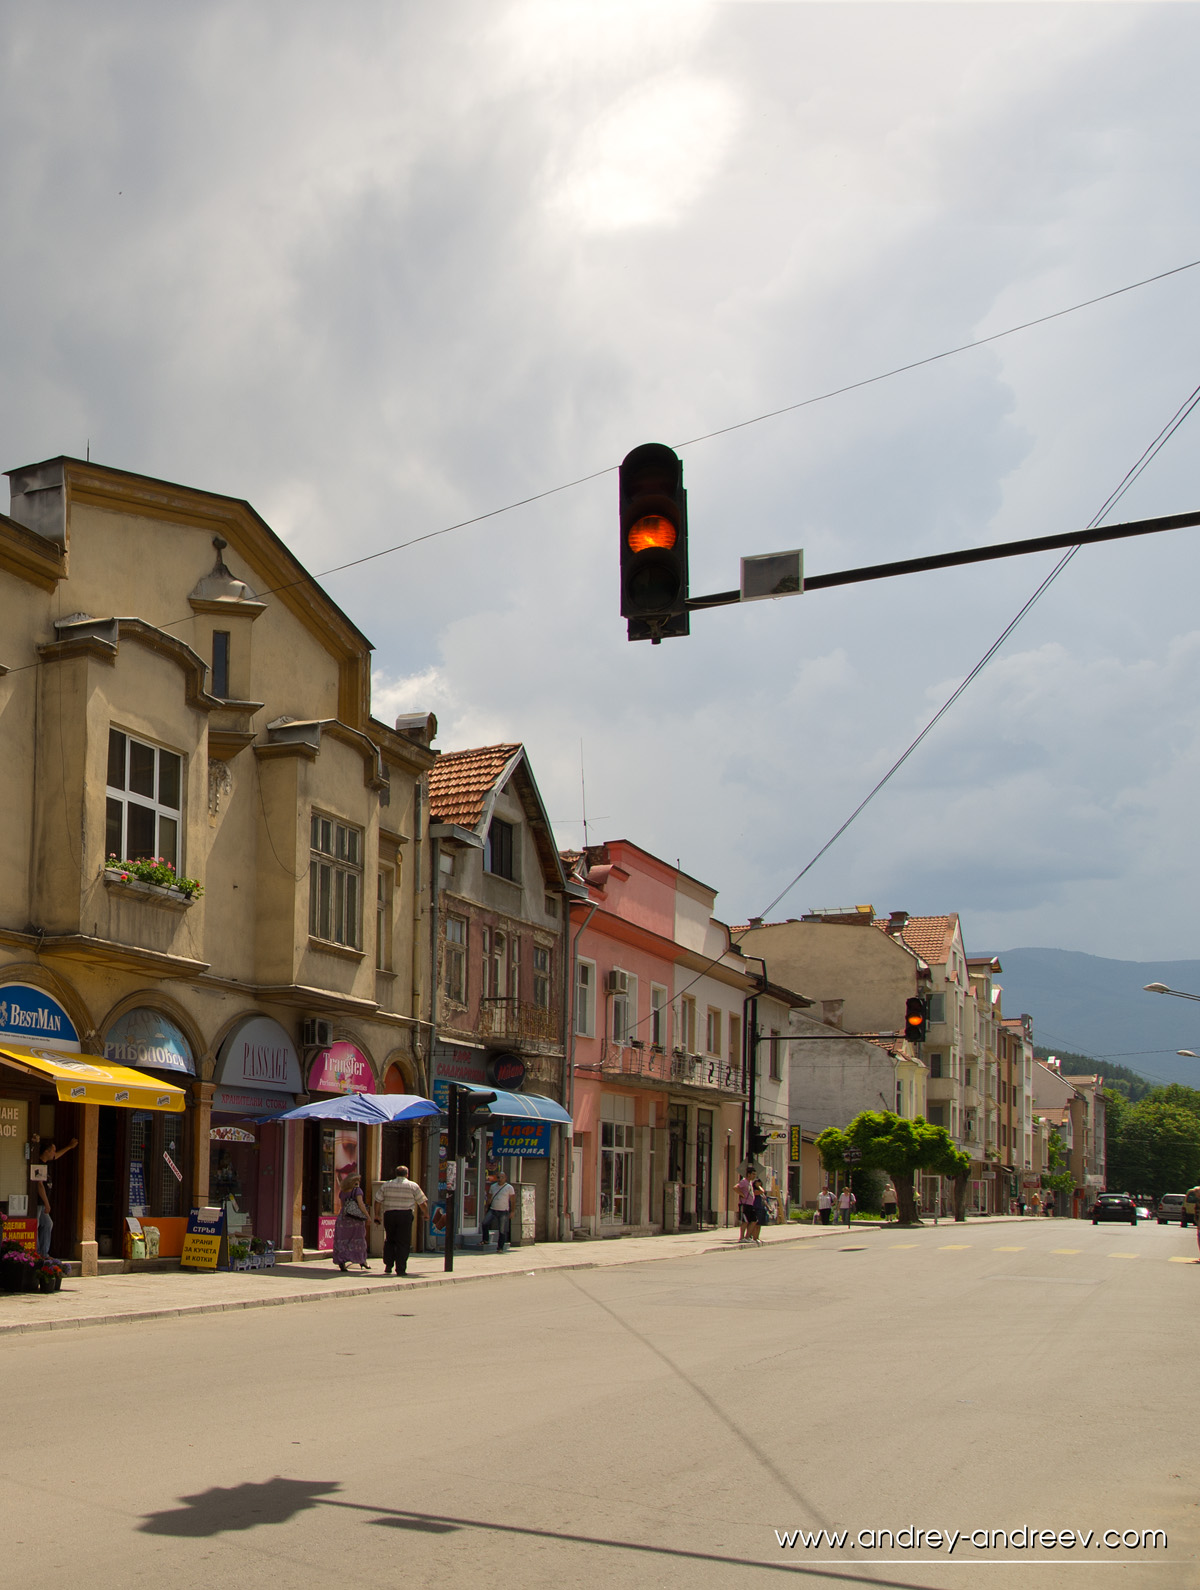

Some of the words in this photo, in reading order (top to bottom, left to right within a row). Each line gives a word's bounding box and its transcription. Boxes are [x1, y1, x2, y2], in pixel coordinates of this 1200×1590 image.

[243, 1042, 288, 1080] PASSAGE
[322, 1052, 365, 1076] Transfer
[501, 1125, 545, 1136] КАФЕ
[503, 1138, 538, 1146] ТОРТИ
[497, 1147, 545, 1155] СЛАДОЛЕД
[2, 1221, 26, 1231] ЗДЕЛИЯ
[8, 1231, 35, 1240] НАПИТКИ
[24, 1241, 36, 1250] АФЕ
